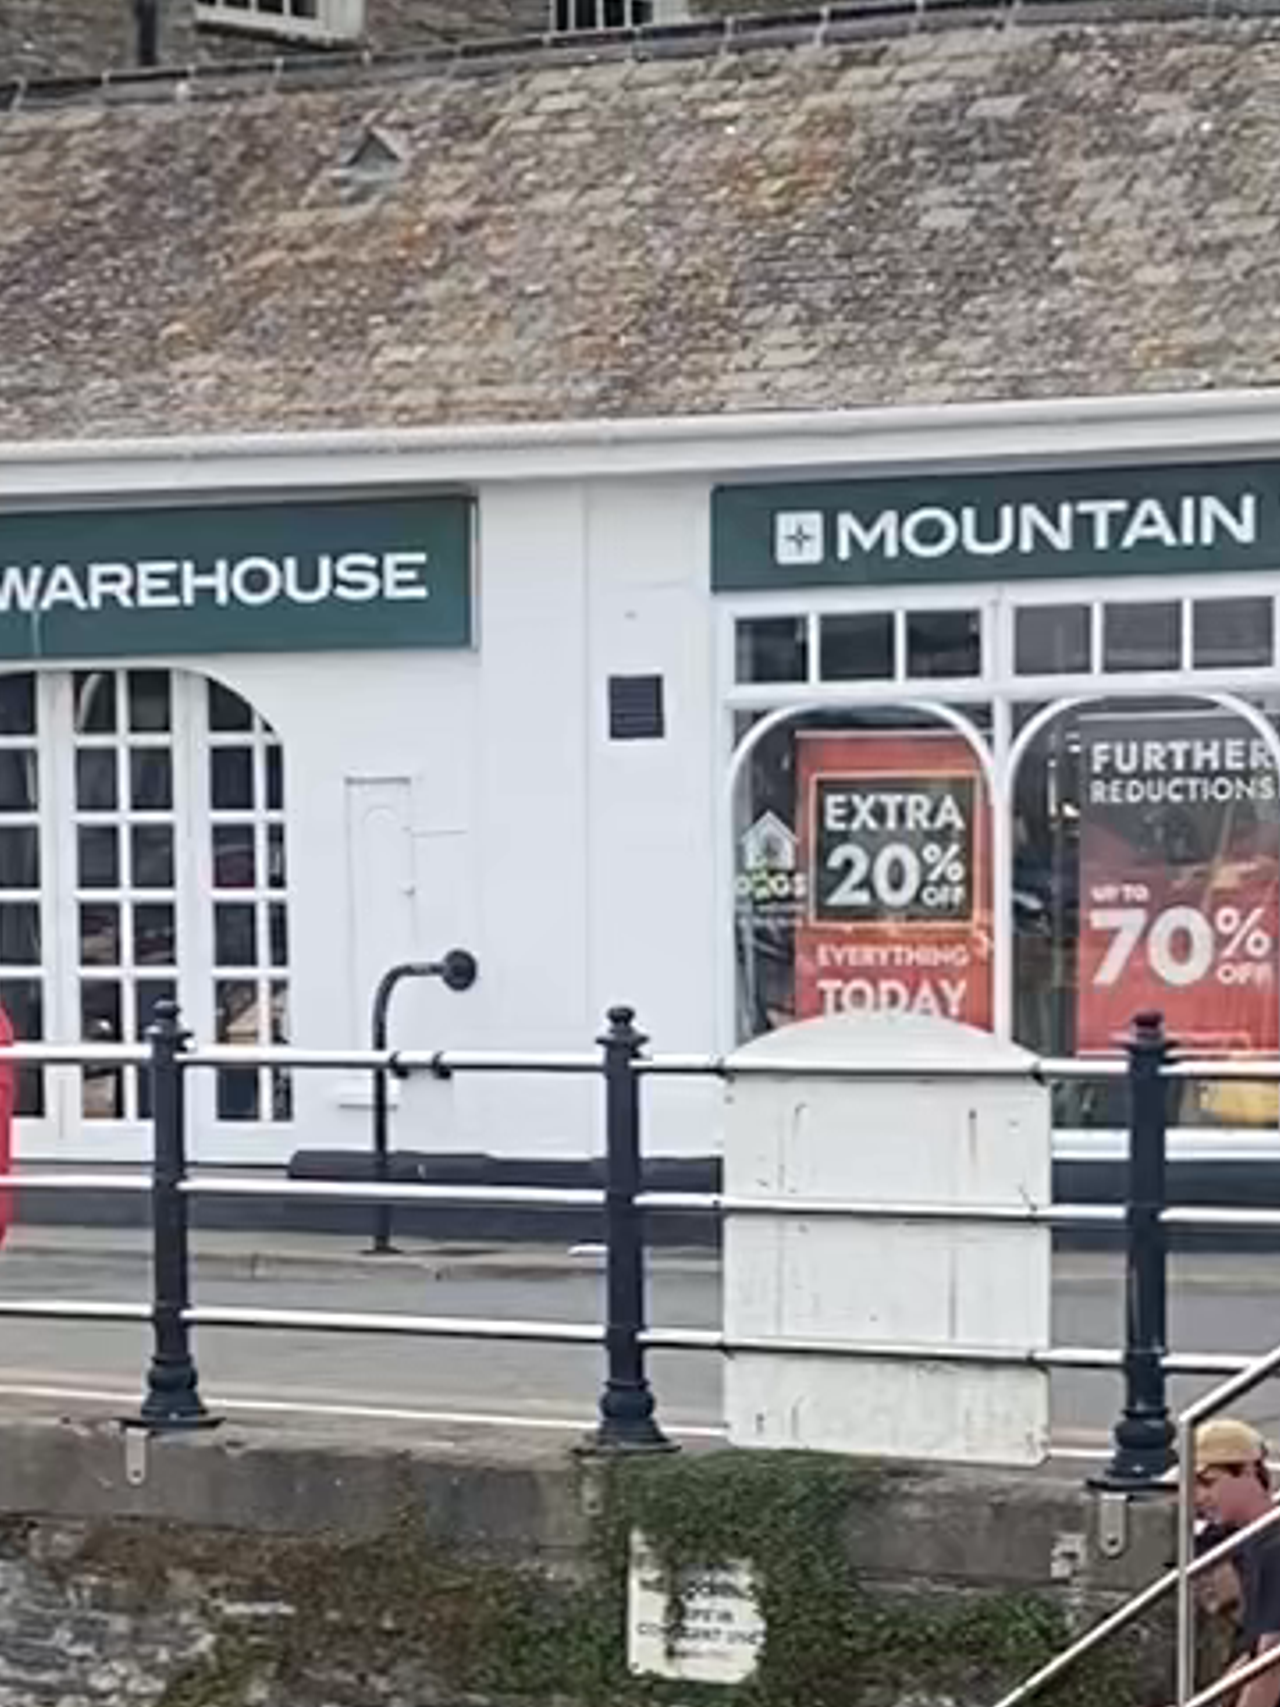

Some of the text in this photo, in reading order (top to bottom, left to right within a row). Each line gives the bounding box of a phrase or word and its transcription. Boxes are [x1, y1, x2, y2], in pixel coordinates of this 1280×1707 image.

[836, 496, 1257, 561] MOUNTAIN
[1091, 740, 1276, 773] FURTHER
[1090, 777, 1276, 803] REDUCTIONS
[824, 794, 965, 831] EXTRA
[825, 843, 966, 907] 20% OFF
[816, 943, 968, 967] EVERYTHING
[1089, 905, 1274, 986] 70% OFF
[816, 977, 967, 1018] TODAY
